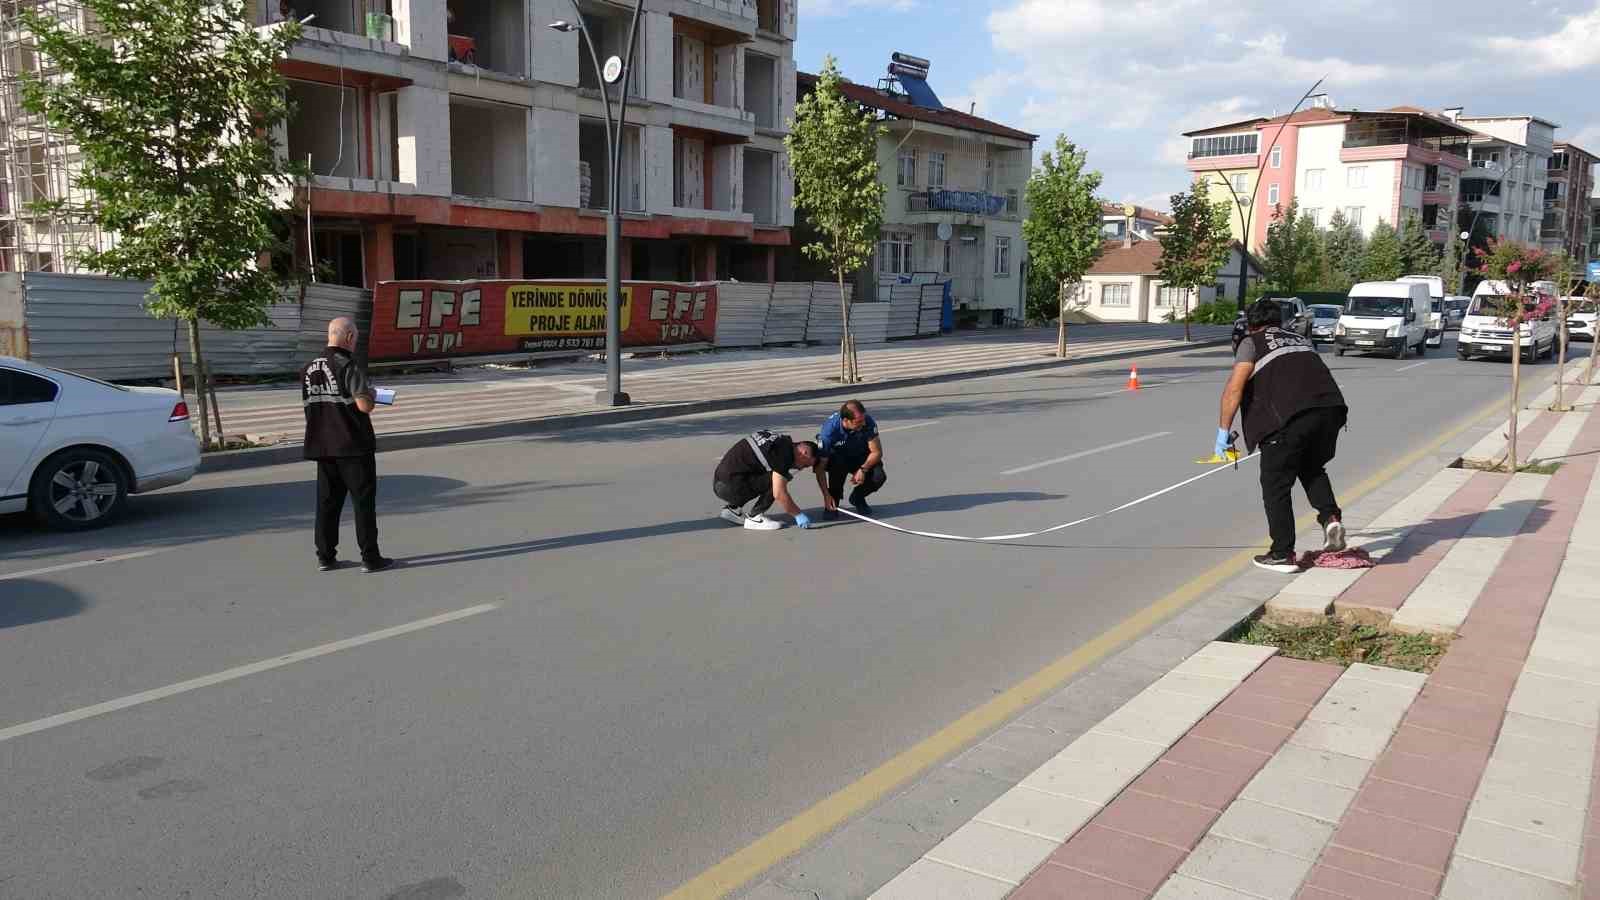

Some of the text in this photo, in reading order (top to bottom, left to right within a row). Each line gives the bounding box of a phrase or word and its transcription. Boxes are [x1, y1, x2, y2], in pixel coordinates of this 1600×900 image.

[396, 289, 481, 329] EFE
[511, 288, 628, 310] YERİNDE DÖNÜŞM
[650, 289, 708, 320] EFE
[529, 314, 571, 331] PROJE
